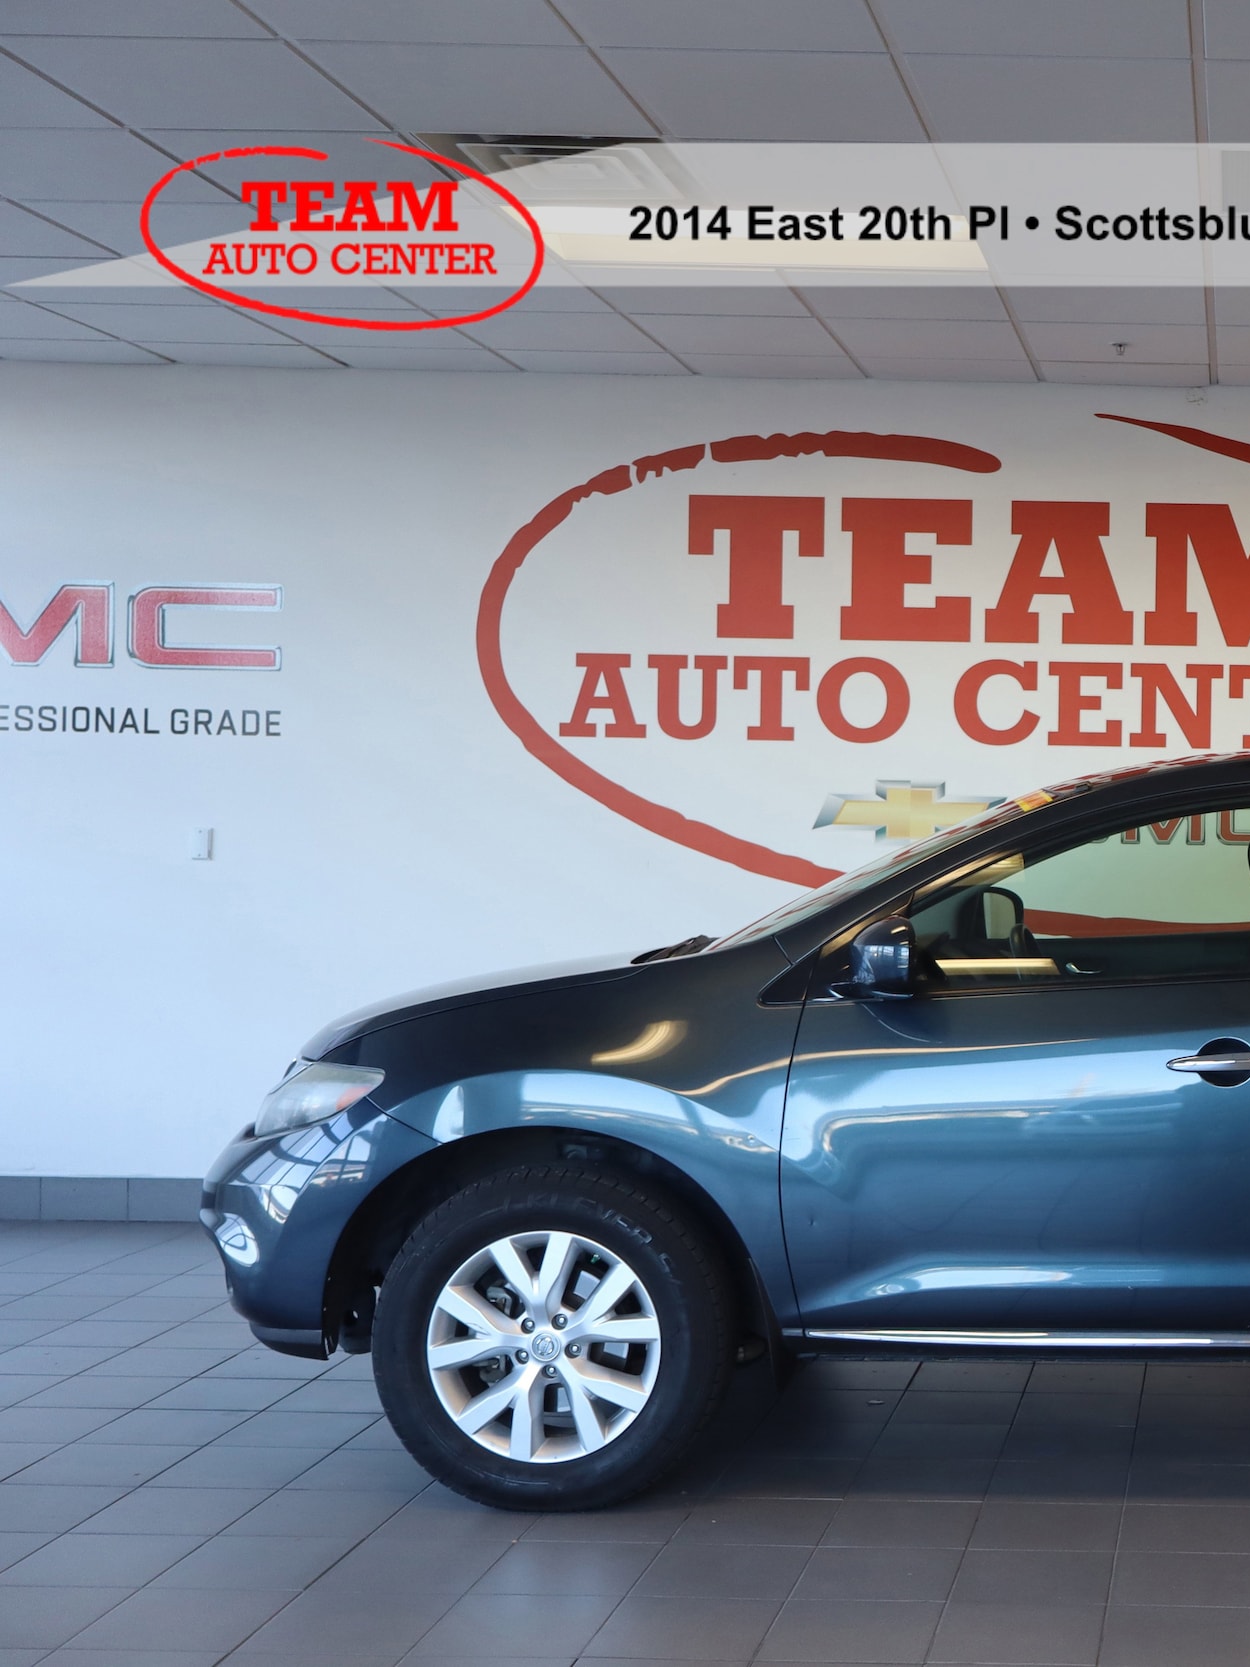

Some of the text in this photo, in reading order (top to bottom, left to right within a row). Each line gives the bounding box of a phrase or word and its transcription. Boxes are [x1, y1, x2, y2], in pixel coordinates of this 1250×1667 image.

[0, 705, 282, 737] ESSIONAL GRADE
[557, 652, 910, 744] AUTO
